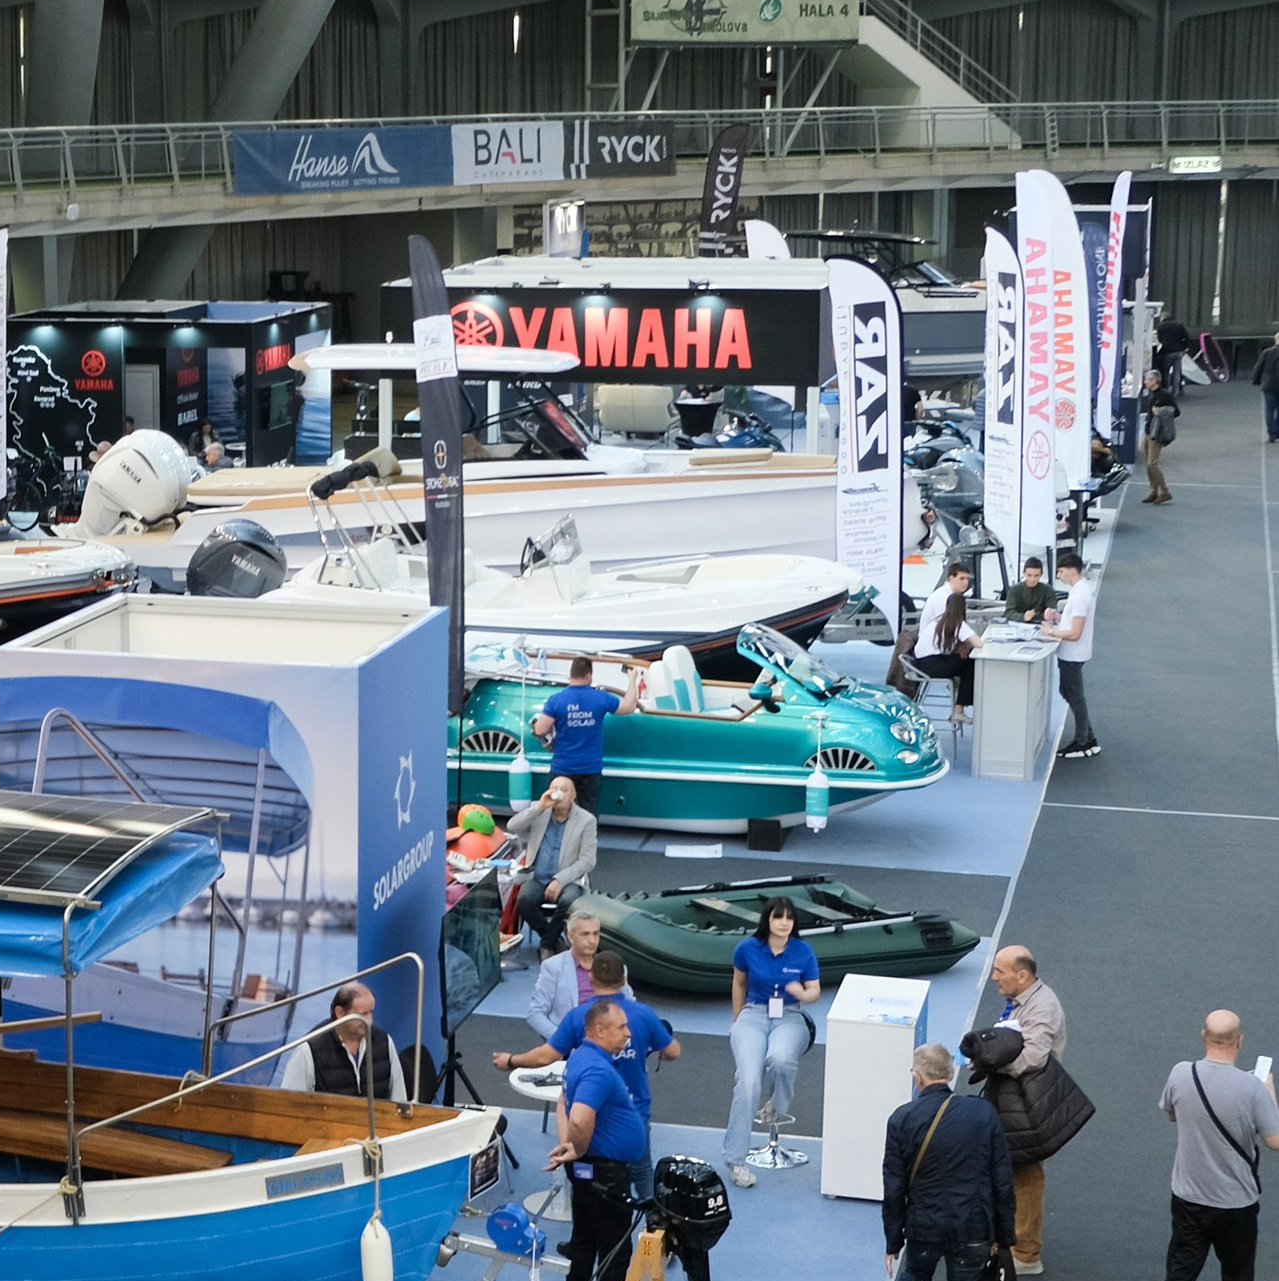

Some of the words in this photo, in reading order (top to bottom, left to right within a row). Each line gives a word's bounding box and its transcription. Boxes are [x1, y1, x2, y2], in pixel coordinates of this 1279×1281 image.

[799, 3, 834, 18] HALA
[839, 3, 850, 17] 4
[288, 133, 349, 182] Hanse
[473, 127, 542, 166] BALI
[597, 134, 662, 163] RYCK
[710, 154, 738, 226] RYCK
[508, 306, 752, 369] YAMAHA
[75, 379, 114, 391] YAMAHA
[177, 409, 199, 426] BAREL
[119, 460, 142, 486] YAMAHA
[231, 554, 261, 577] YAMAHA
[567, 711, 593, 719] FROM
[567, 718, 596, 728] SOLAR
[373, 829, 435, 912] SOLARGROUP
[707, 1194, 724, 1209] 9.8
